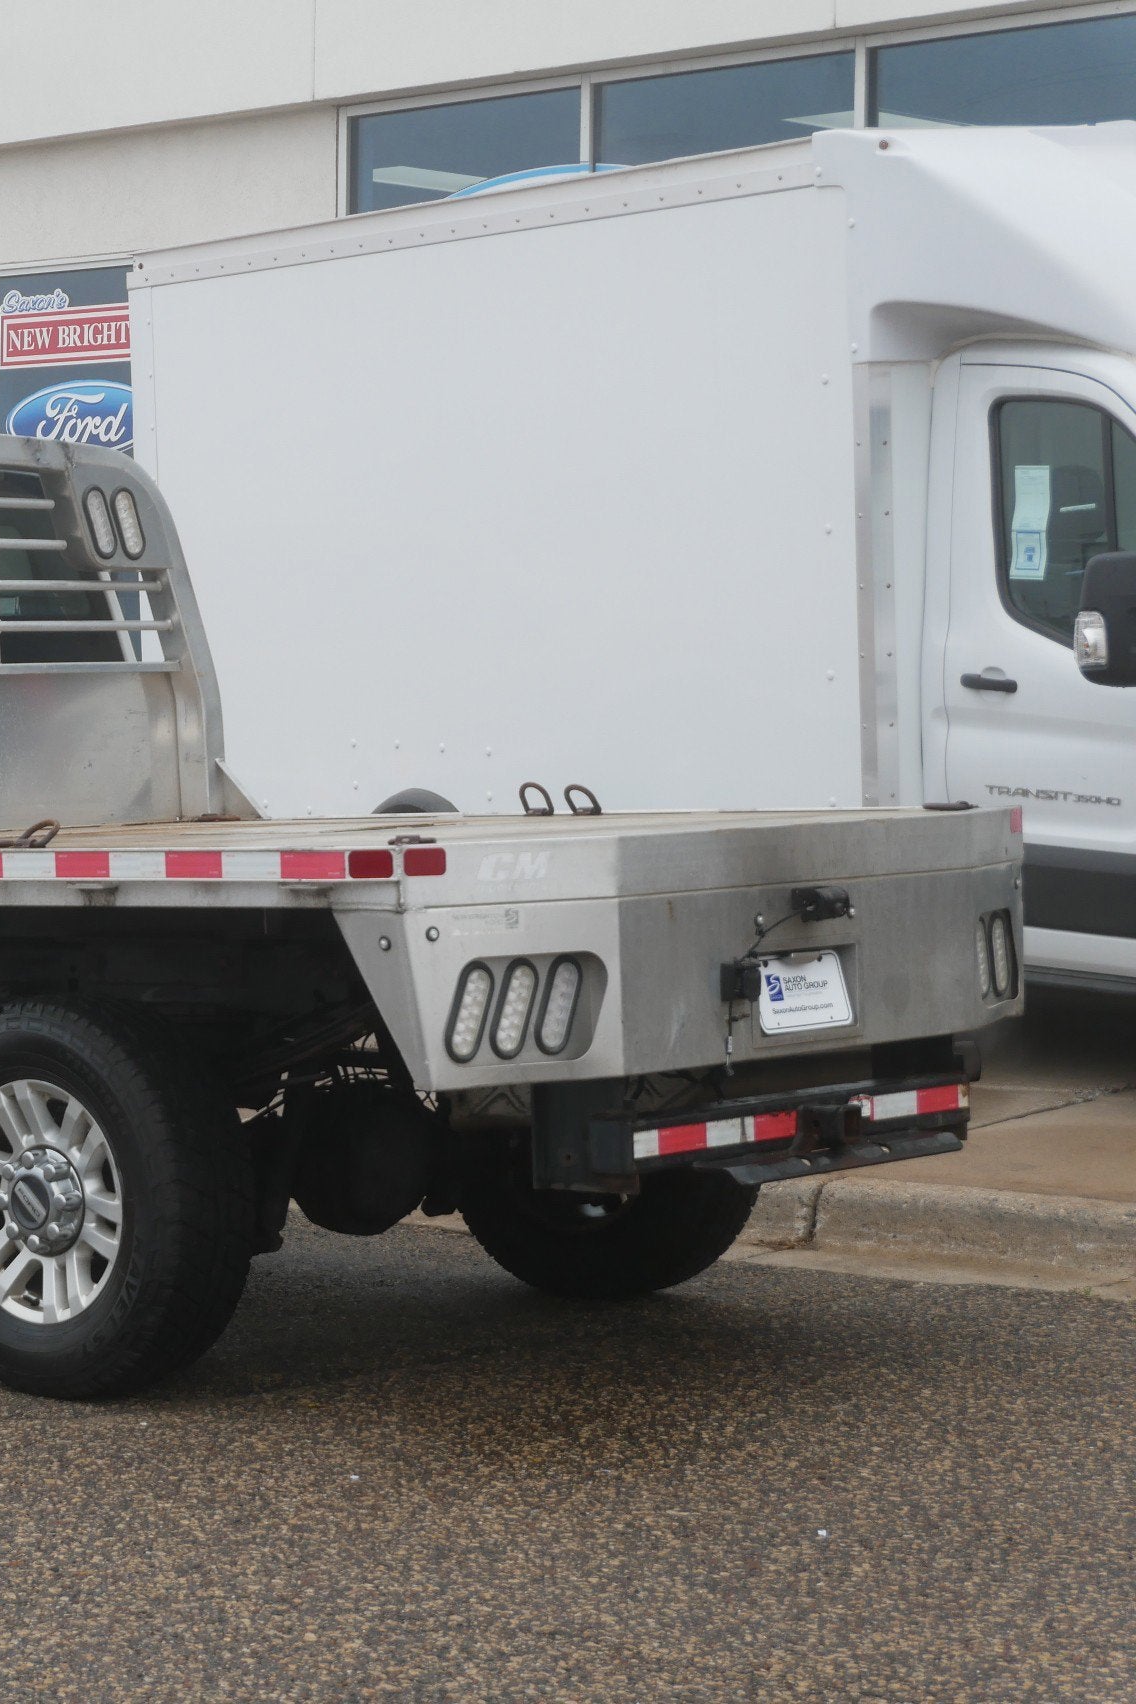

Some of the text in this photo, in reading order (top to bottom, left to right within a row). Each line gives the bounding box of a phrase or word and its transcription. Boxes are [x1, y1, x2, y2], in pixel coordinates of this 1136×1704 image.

[1, 288, 69, 313] Saxon's
[8, 326, 53, 351] NEW
[36, 392, 129, 443] Ford
[984, 785, 1073, 802] TRANSIT
[477, 851, 552, 881] CM
[783, 975, 807, 984] SAXON
[784, 980, 828, 992] AUTO GROUP
[17, 1186, 42, 1218] FORD
